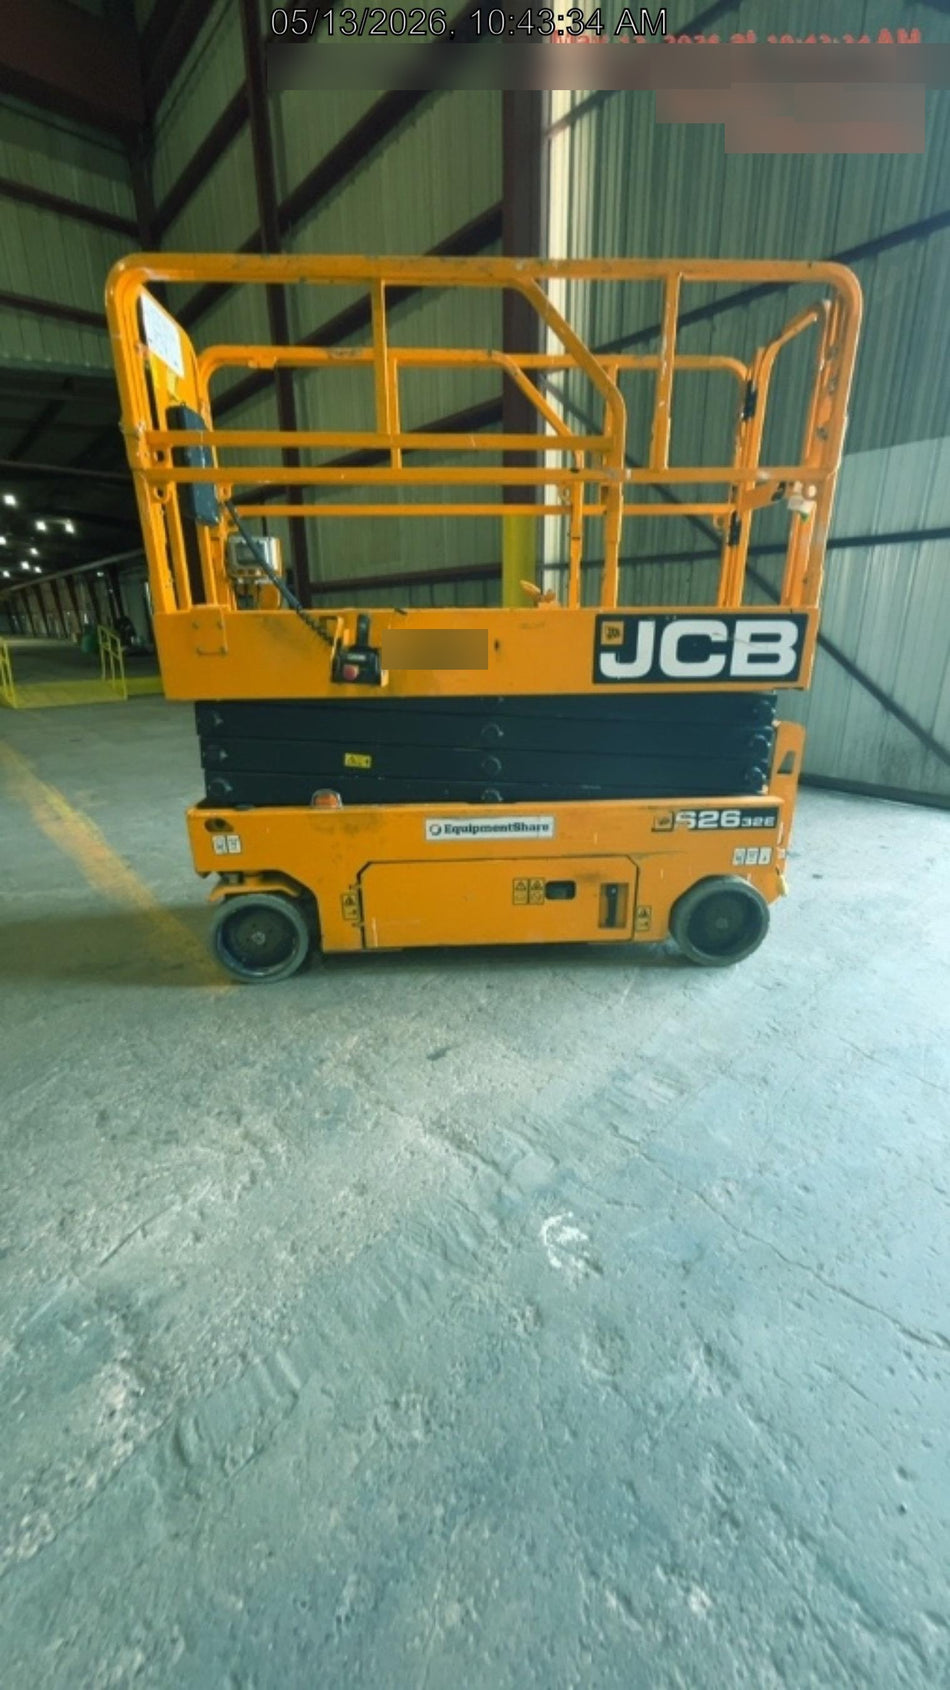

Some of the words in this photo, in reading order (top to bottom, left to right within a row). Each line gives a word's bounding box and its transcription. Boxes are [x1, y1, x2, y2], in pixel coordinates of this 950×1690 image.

[600, 619, 798, 678] JCB
[444, 822, 549, 835] EquipmentShare
[675, 809, 741, 829] S26
